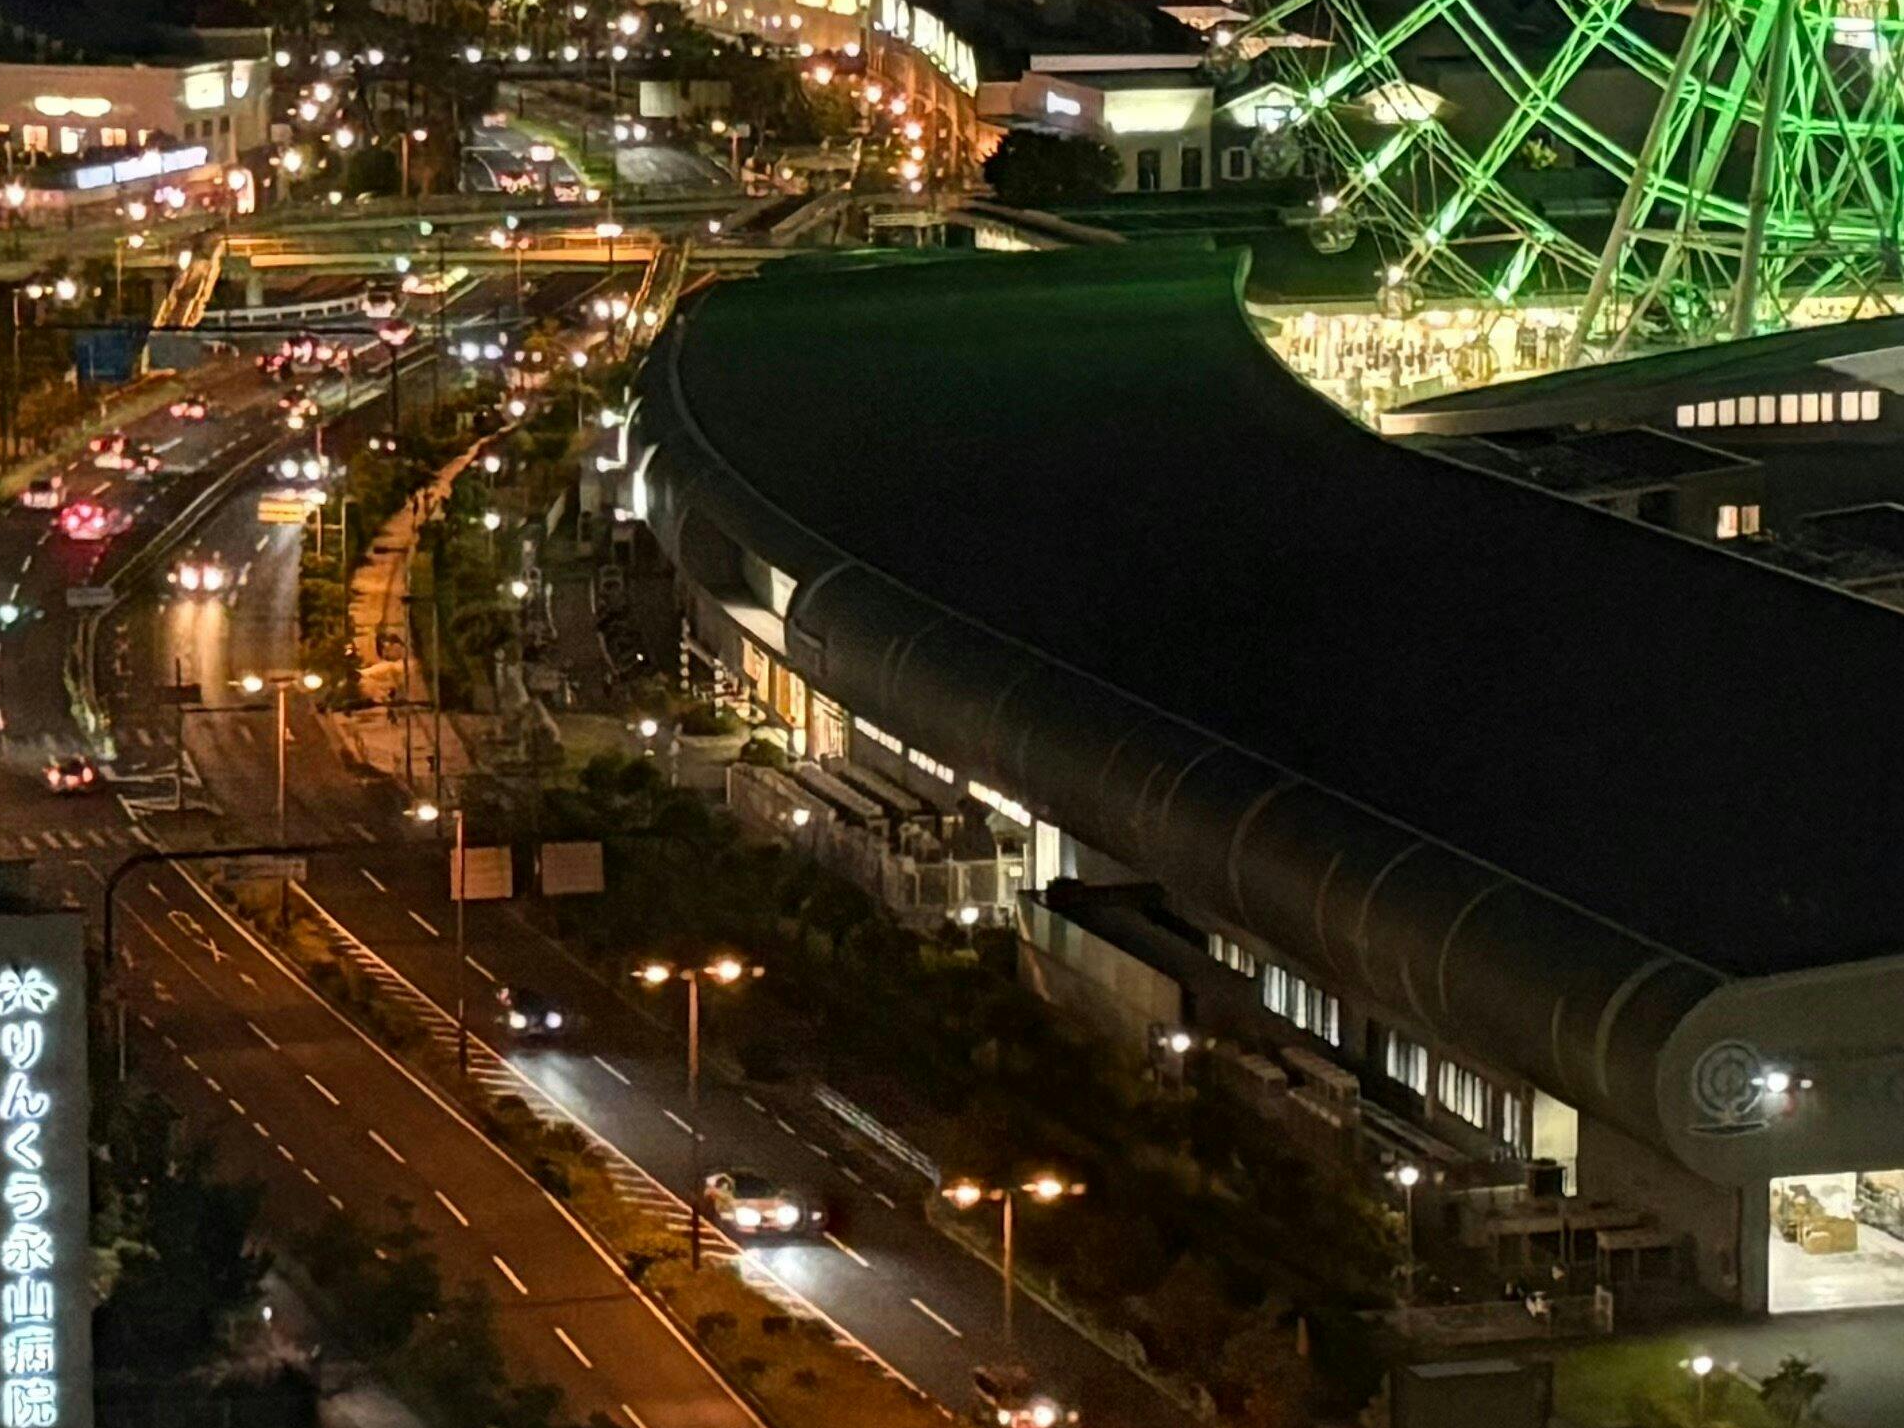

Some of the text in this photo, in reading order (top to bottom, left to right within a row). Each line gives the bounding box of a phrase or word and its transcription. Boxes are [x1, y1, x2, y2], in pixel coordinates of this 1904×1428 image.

[0, 1020, 57, 1428] りんくう永山病院
